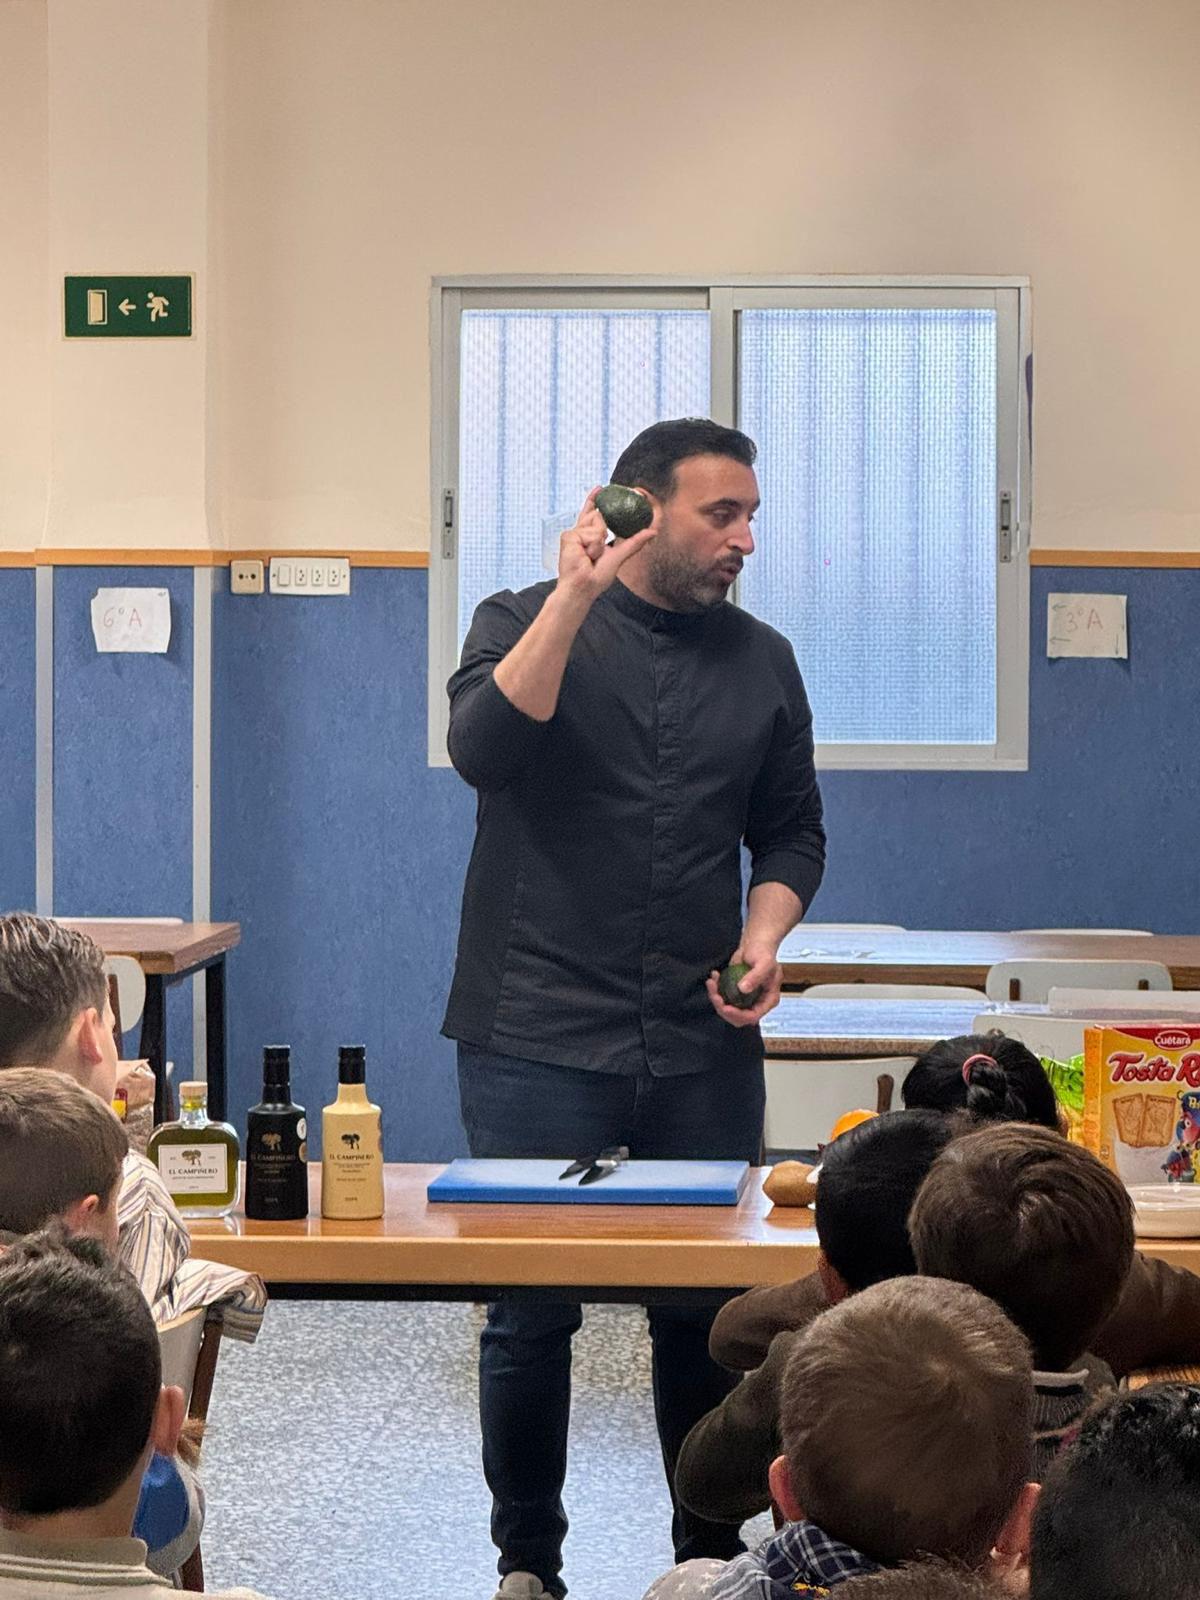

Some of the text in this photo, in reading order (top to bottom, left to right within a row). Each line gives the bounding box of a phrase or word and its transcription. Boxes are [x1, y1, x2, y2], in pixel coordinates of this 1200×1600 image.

[1154, 1034, 1191, 1046] Cuétara
[1108, 1052, 1200, 1088] Tosta R
